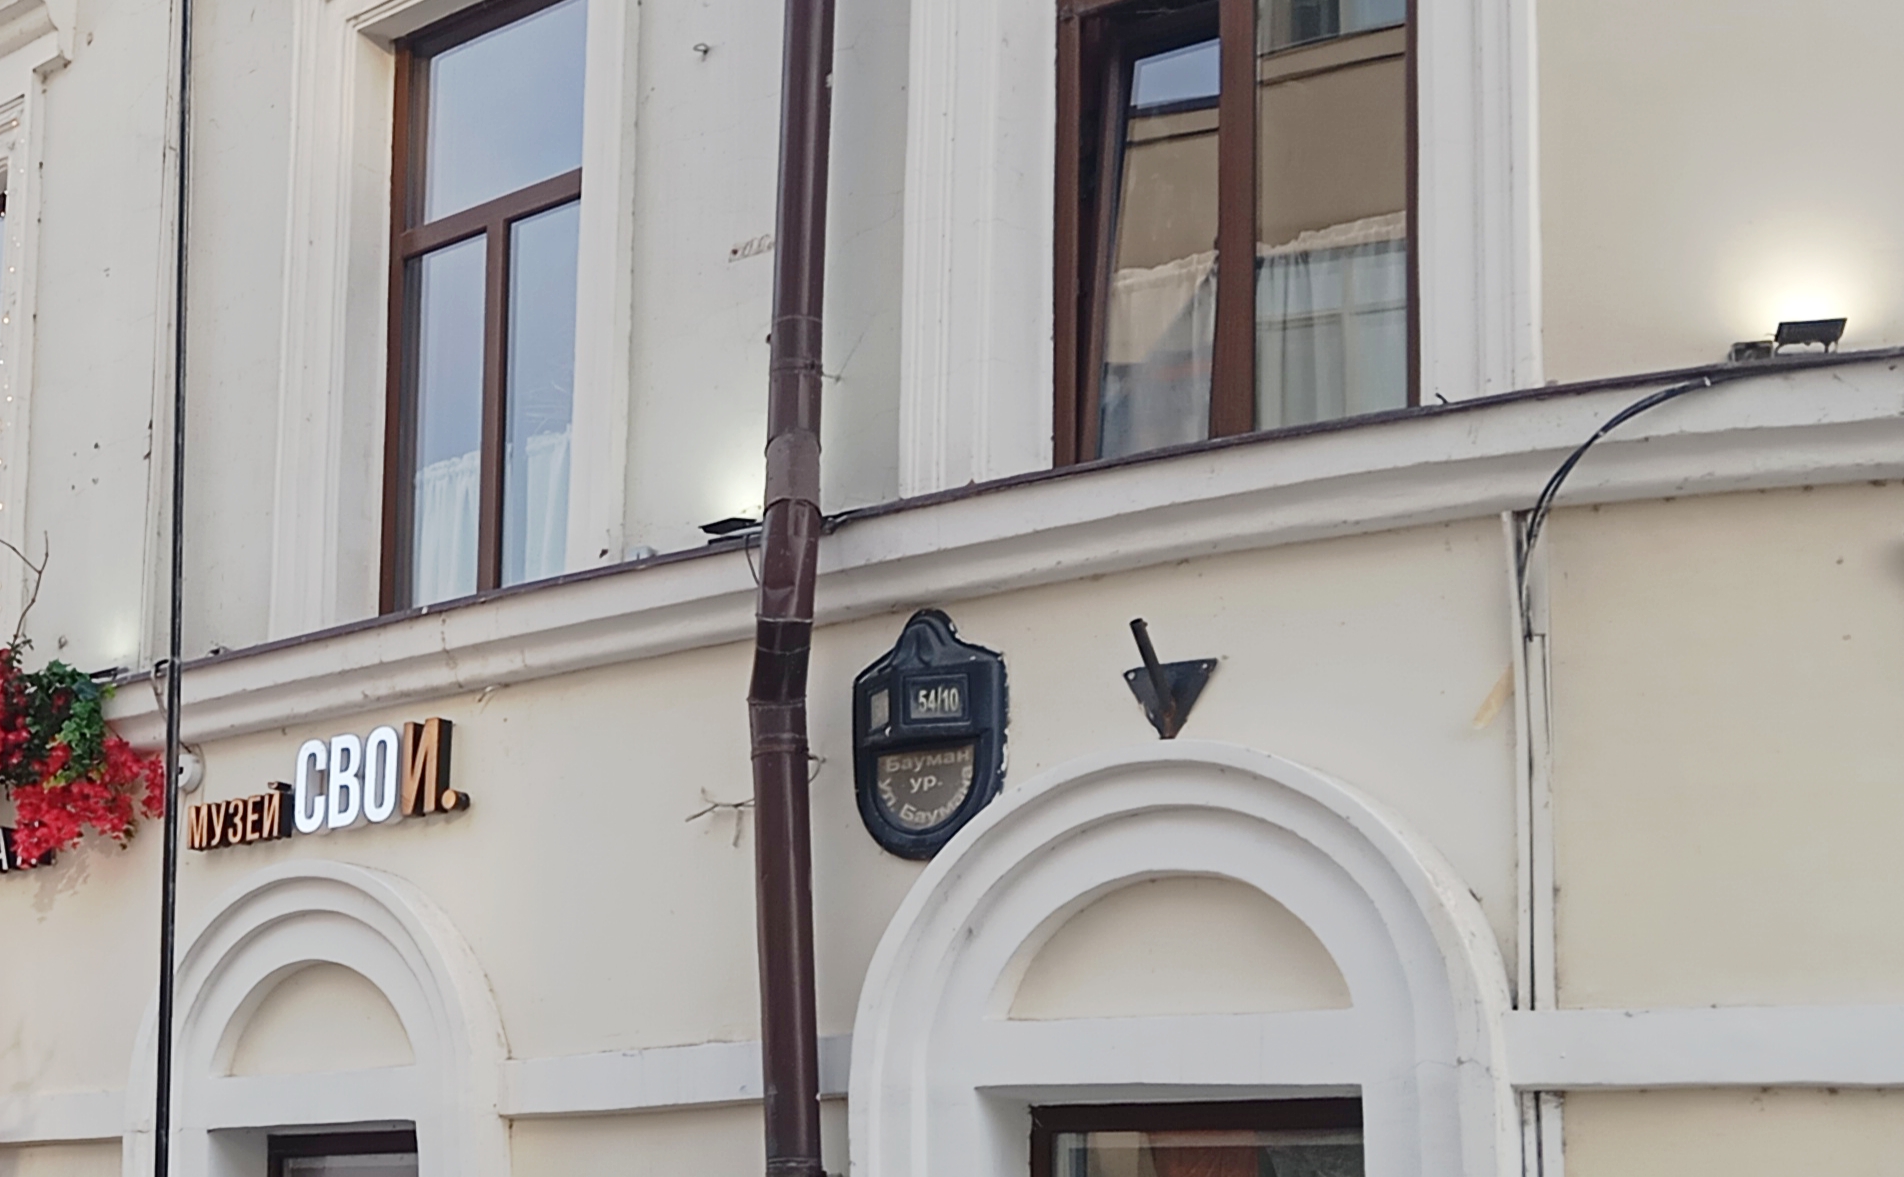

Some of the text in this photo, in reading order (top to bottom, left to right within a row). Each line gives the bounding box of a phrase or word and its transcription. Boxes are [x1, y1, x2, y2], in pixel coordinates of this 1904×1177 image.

[917, 686, 960, 714] 54/10
[885, 748, 972, 774] Бауман
[899, 764, 973, 826] Баумана
[910, 775, 944, 793] ур.
[187, 781, 292, 851] МУЗЕЙ
